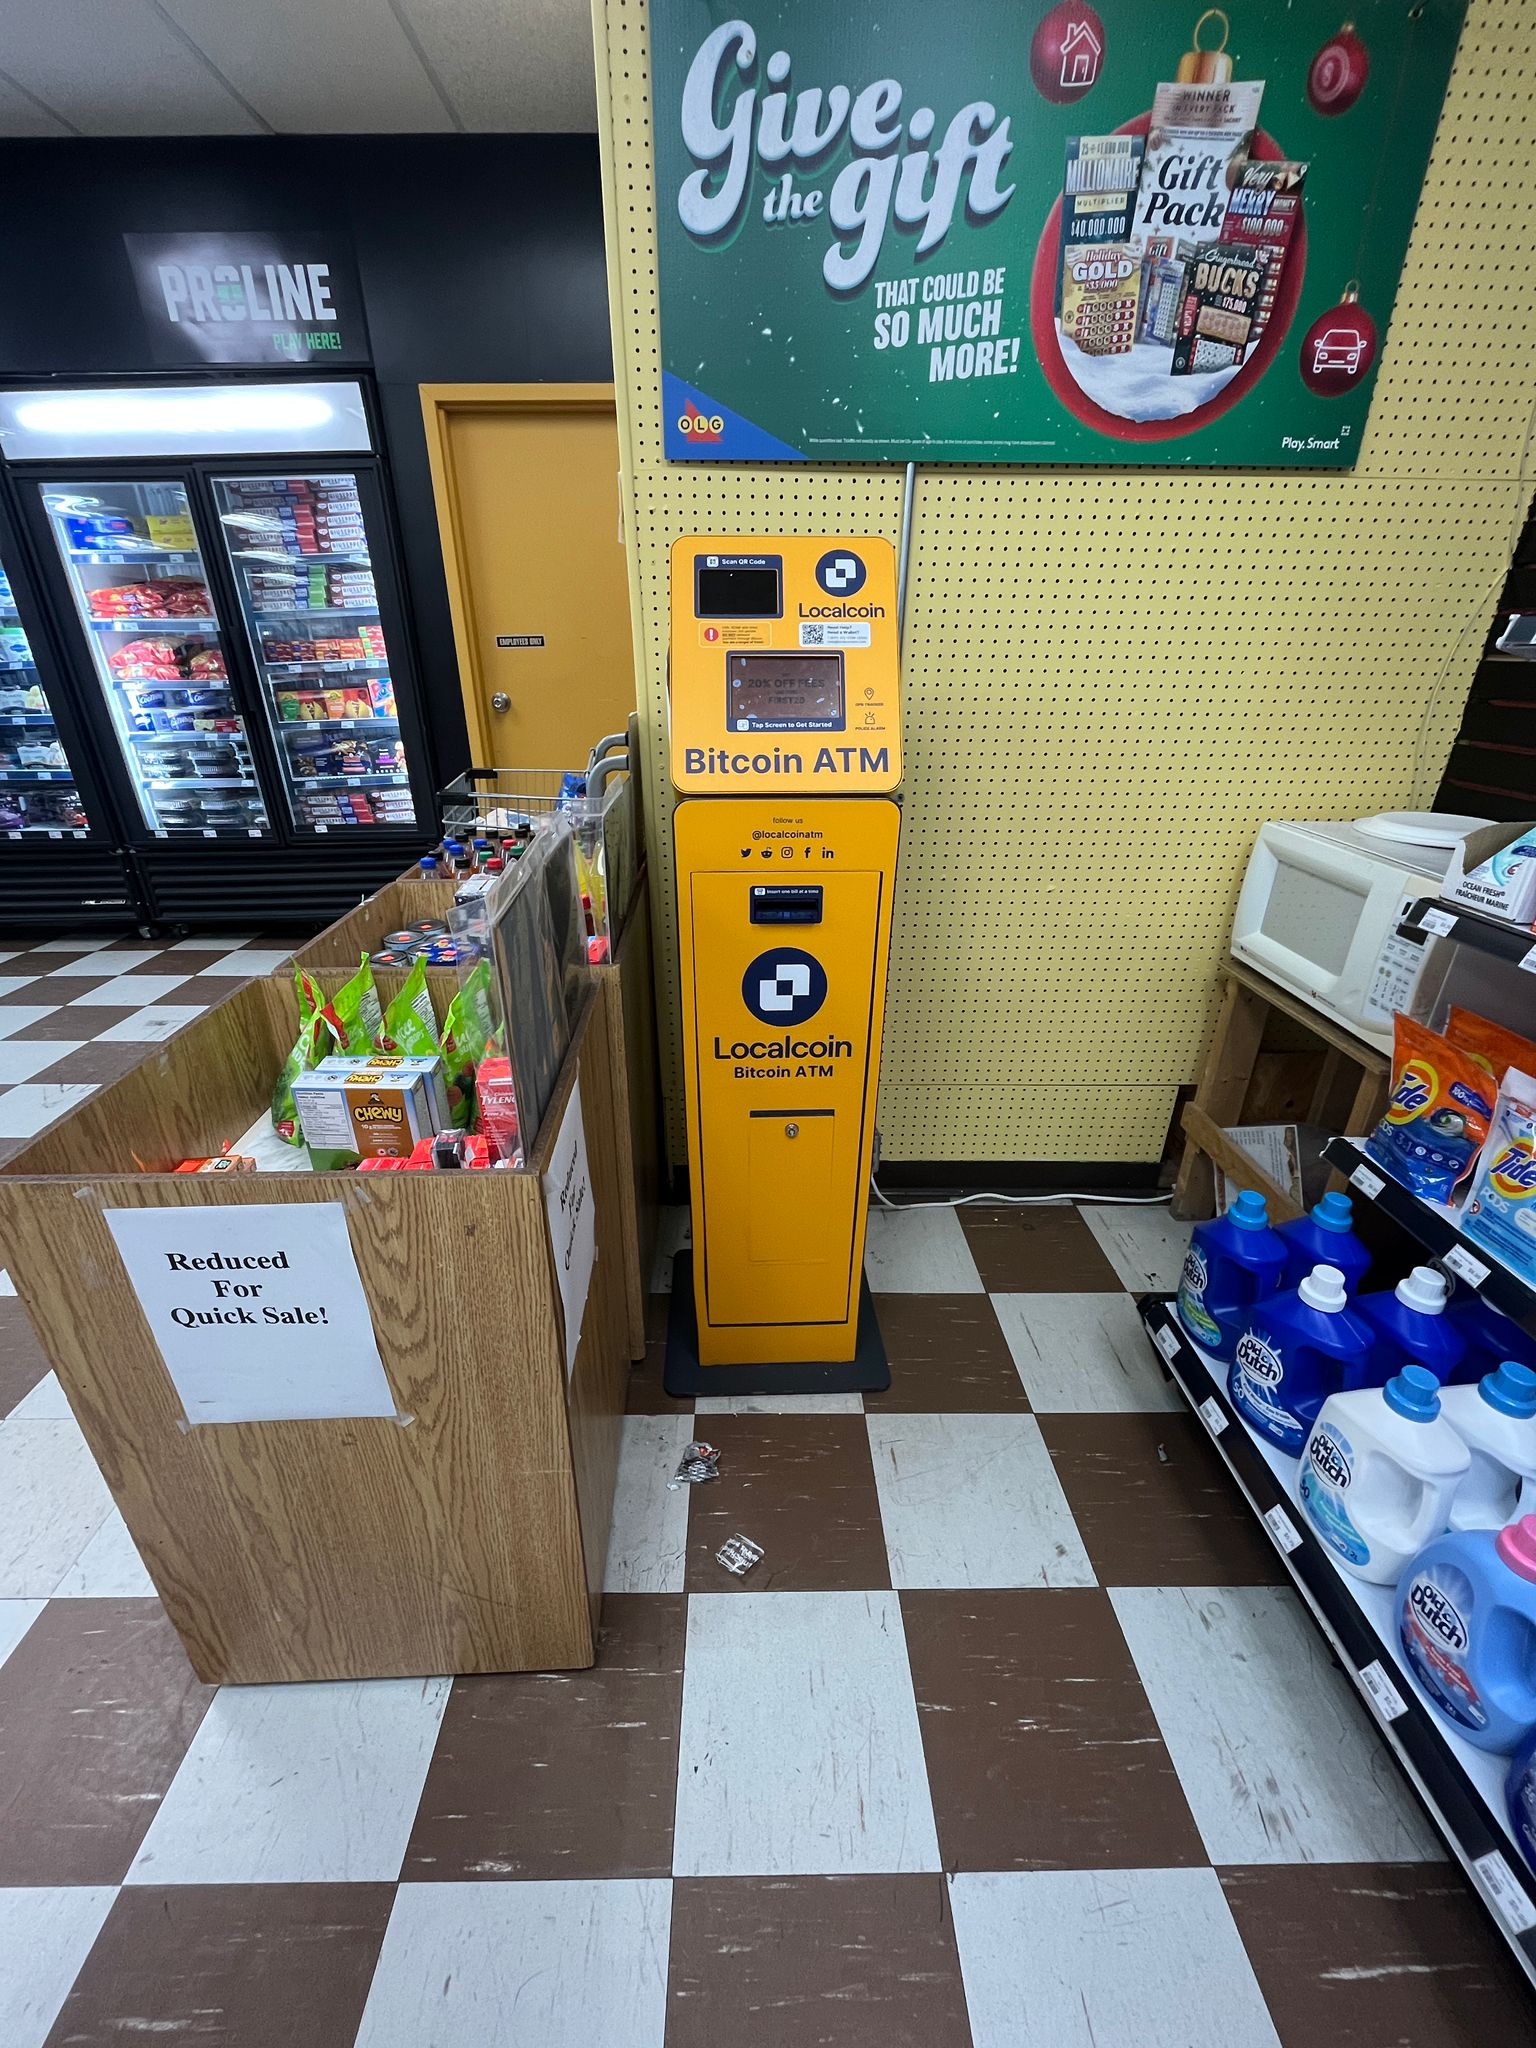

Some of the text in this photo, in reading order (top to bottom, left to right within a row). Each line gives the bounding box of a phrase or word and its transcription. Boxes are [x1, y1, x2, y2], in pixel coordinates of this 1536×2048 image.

[1183, 89, 1231, 102] WINNER
[678, 20, 902, 235] Give
[1159, 154, 1224, 191] Gift
[763, 100, 1017, 289] the gift
[1228, 187, 1276, 216] MERRY
[1142, 191, 1226, 228] Pack
[1242, 217, 1285, 237] $100,000
[1086, 249, 1122, 261] Holiday
[1072, 260, 1133, 282] GOLD
[1195, 262, 1260, 299] BUCKS
[157, 263, 337, 322] PROLINE
[875, 267, 1006, 309] THAT COULD BE
[873, 300, 1003, 350] SO MUCH
[273, 332, 342, 350] PLAY HERE!
[929, 337, 1021, 383] MORE!
[677, 414, 724, 434] OLG
[798, 602, 886, 619] Localcoin
[500, 637, 542, 646] EMPLOYEES ONLY
[748, 679, 826, 689] 20% OFF FEES
[752, 721, 764, 729] Tap
[685, 747, 890, 775] Bitcoin ATM
[772, 816, 792, 825] follow
[752, 829, 823, 841] @localcoinatm
[1462, 880, 1483, 893] OCEAN
[1485, 897, 1510, 912] MARINE
[713, 1035, 852, 1060] Localcoin
[734, 1065, 834, 1079] Bitcoin ATM
[480, 1092, 516, 1105] TYLENO
[1490, 1147, 1536, 1187] Tide
[1480, 1186, 1511, 1214] PODS
[164, 1250, 290, 1272] Reduced
[211, 1279, 263, 1299] For
[171, 1306, 329, 1329] Quick Sale!
[1247, 1340, 1262, 1355] Old
[1238, 1342, 1278, 1381] Dutch
[1320, 1434, 1334, 1456] Old
[1310, 1436, 1348, 1488] Dutch
[1423, 1585, 1446, 1612] Old
[1411, 1584, 1464, 1649] Dutch
